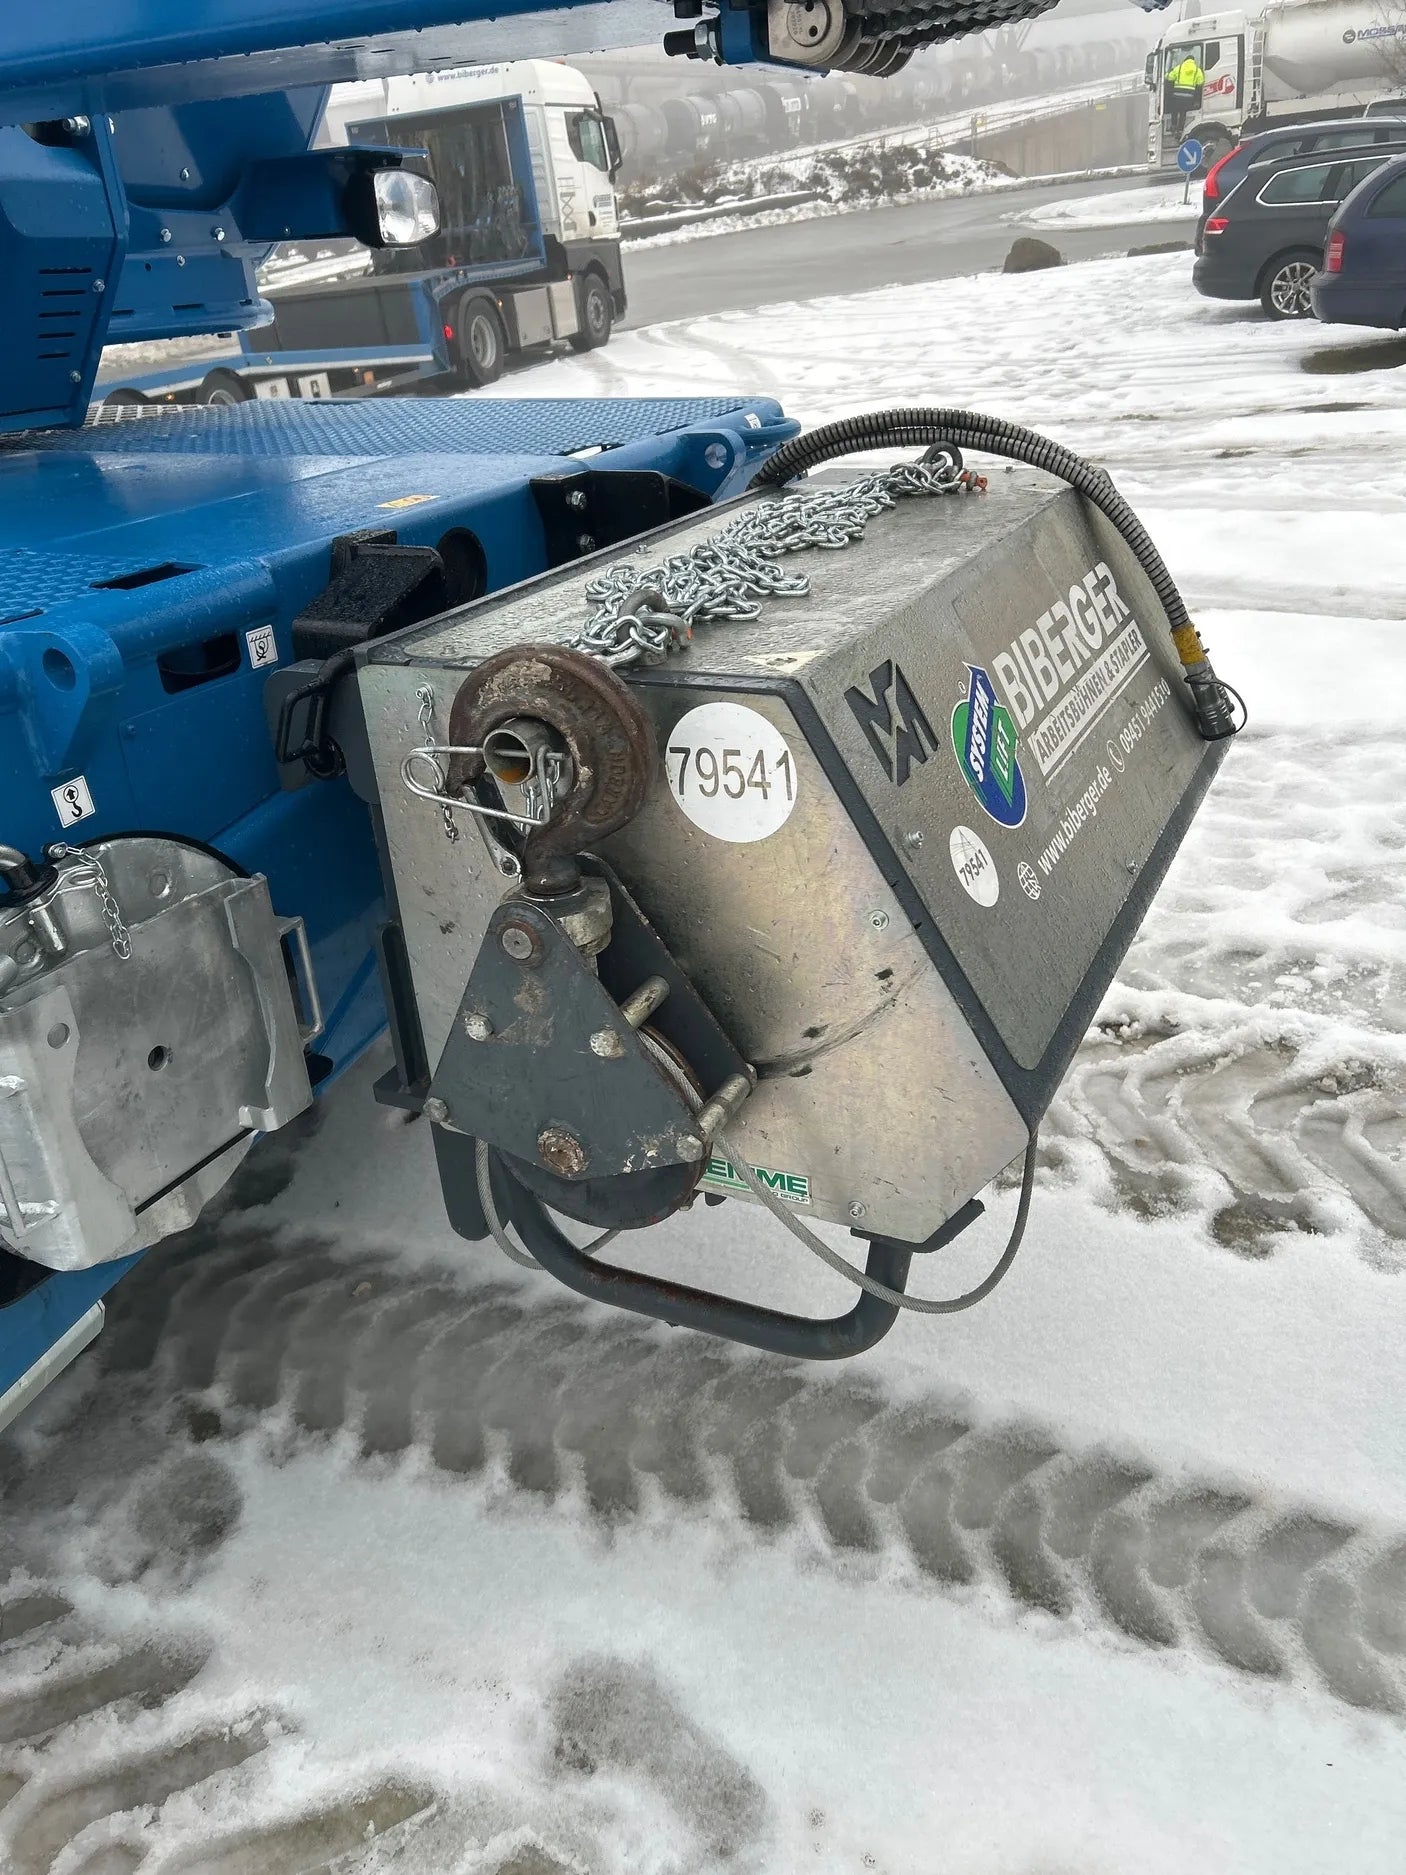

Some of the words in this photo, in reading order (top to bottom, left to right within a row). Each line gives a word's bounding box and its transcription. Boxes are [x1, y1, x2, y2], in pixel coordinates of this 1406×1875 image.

[992, 562, 1131, 730] BIBERGER
[1035, 667, 1110, 764] ARBEITSBÜHNEN
[1103, 660, 1116, 682] &
[1110, 629, 1142, 674] STAPLER
[669, 746, 793, 801] 79541
[969, 679, 990, 783] SYSTEM
[996, 717, 1010, 781] LIFT
[1037, 765, 1113, 876] www.biberger.de
[1119, 712, 1146, 754] 09451
[1140, 677, 1171, 725] 9441510
[959, 848, 989, 887] 79541
